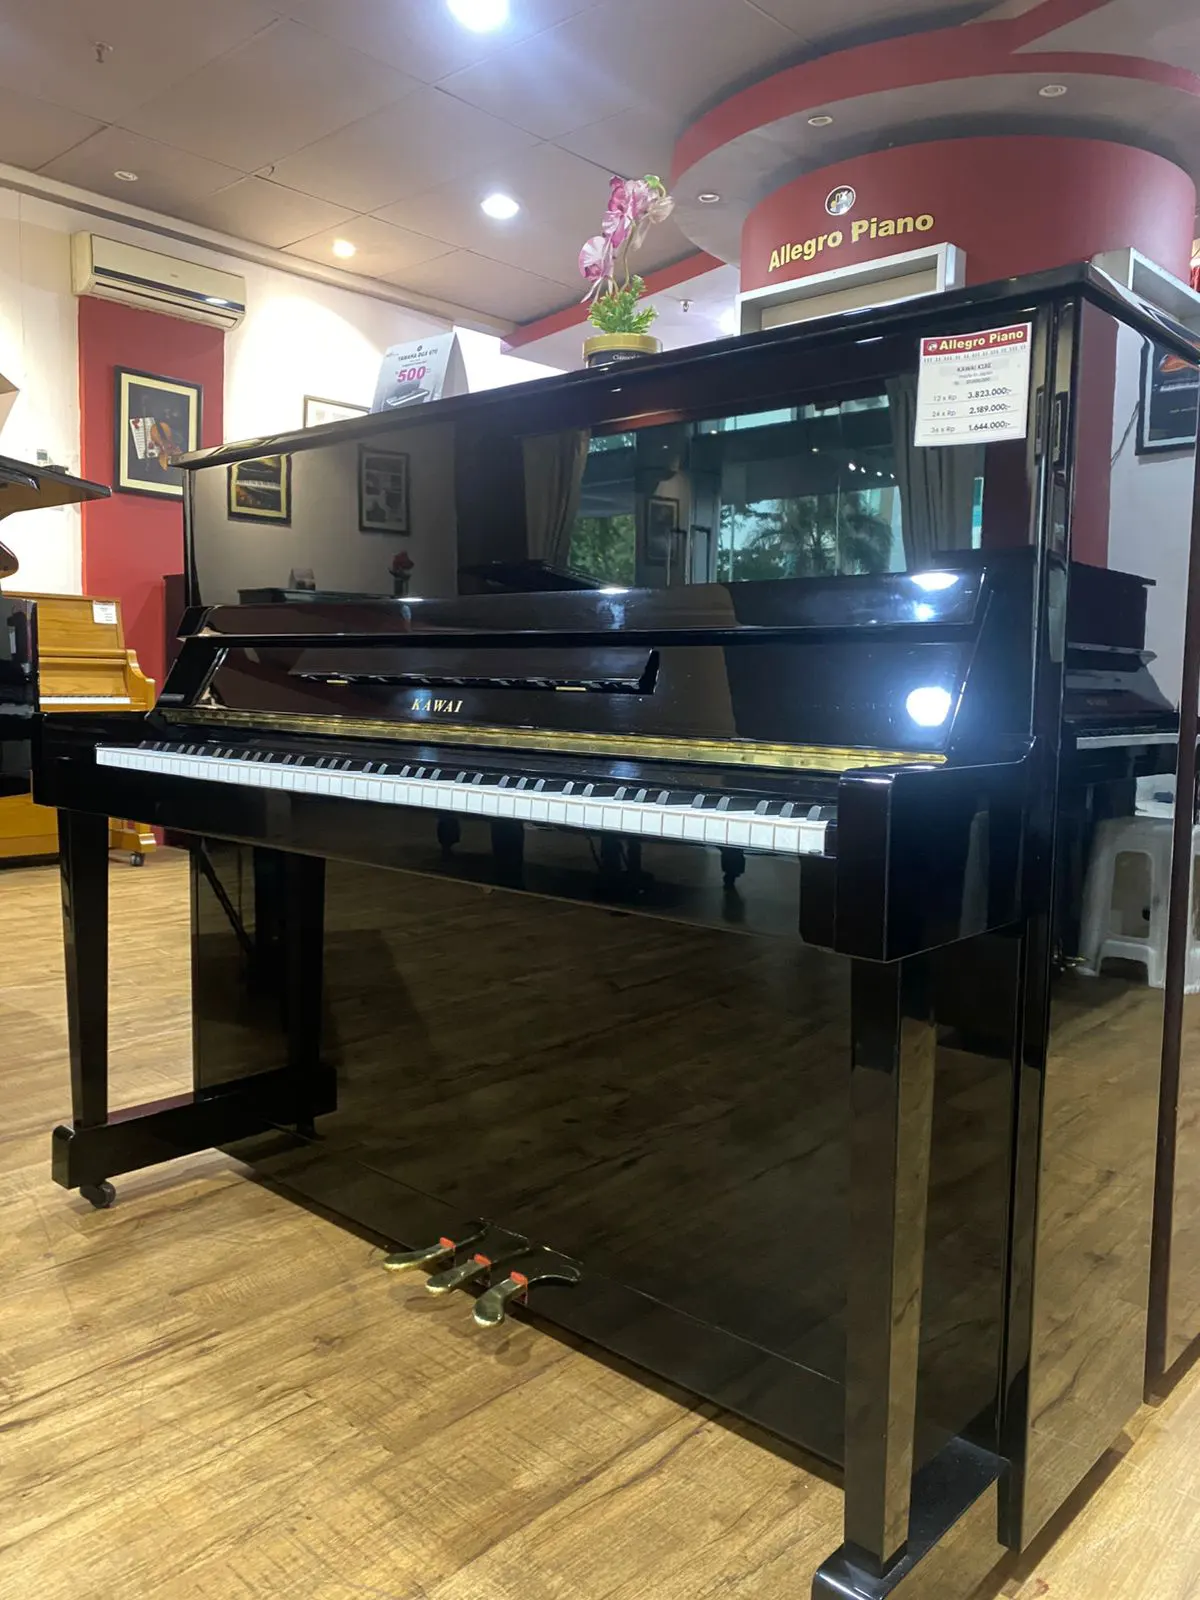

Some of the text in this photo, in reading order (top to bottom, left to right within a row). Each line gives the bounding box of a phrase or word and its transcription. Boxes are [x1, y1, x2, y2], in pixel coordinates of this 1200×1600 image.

[767, 213, 935, 273] Allegro Piano
[939, 330, 1024, 351] Allegro Piano
[397, 366, 426, 383] 500
[411, 698, 463, 713] KAWAI
